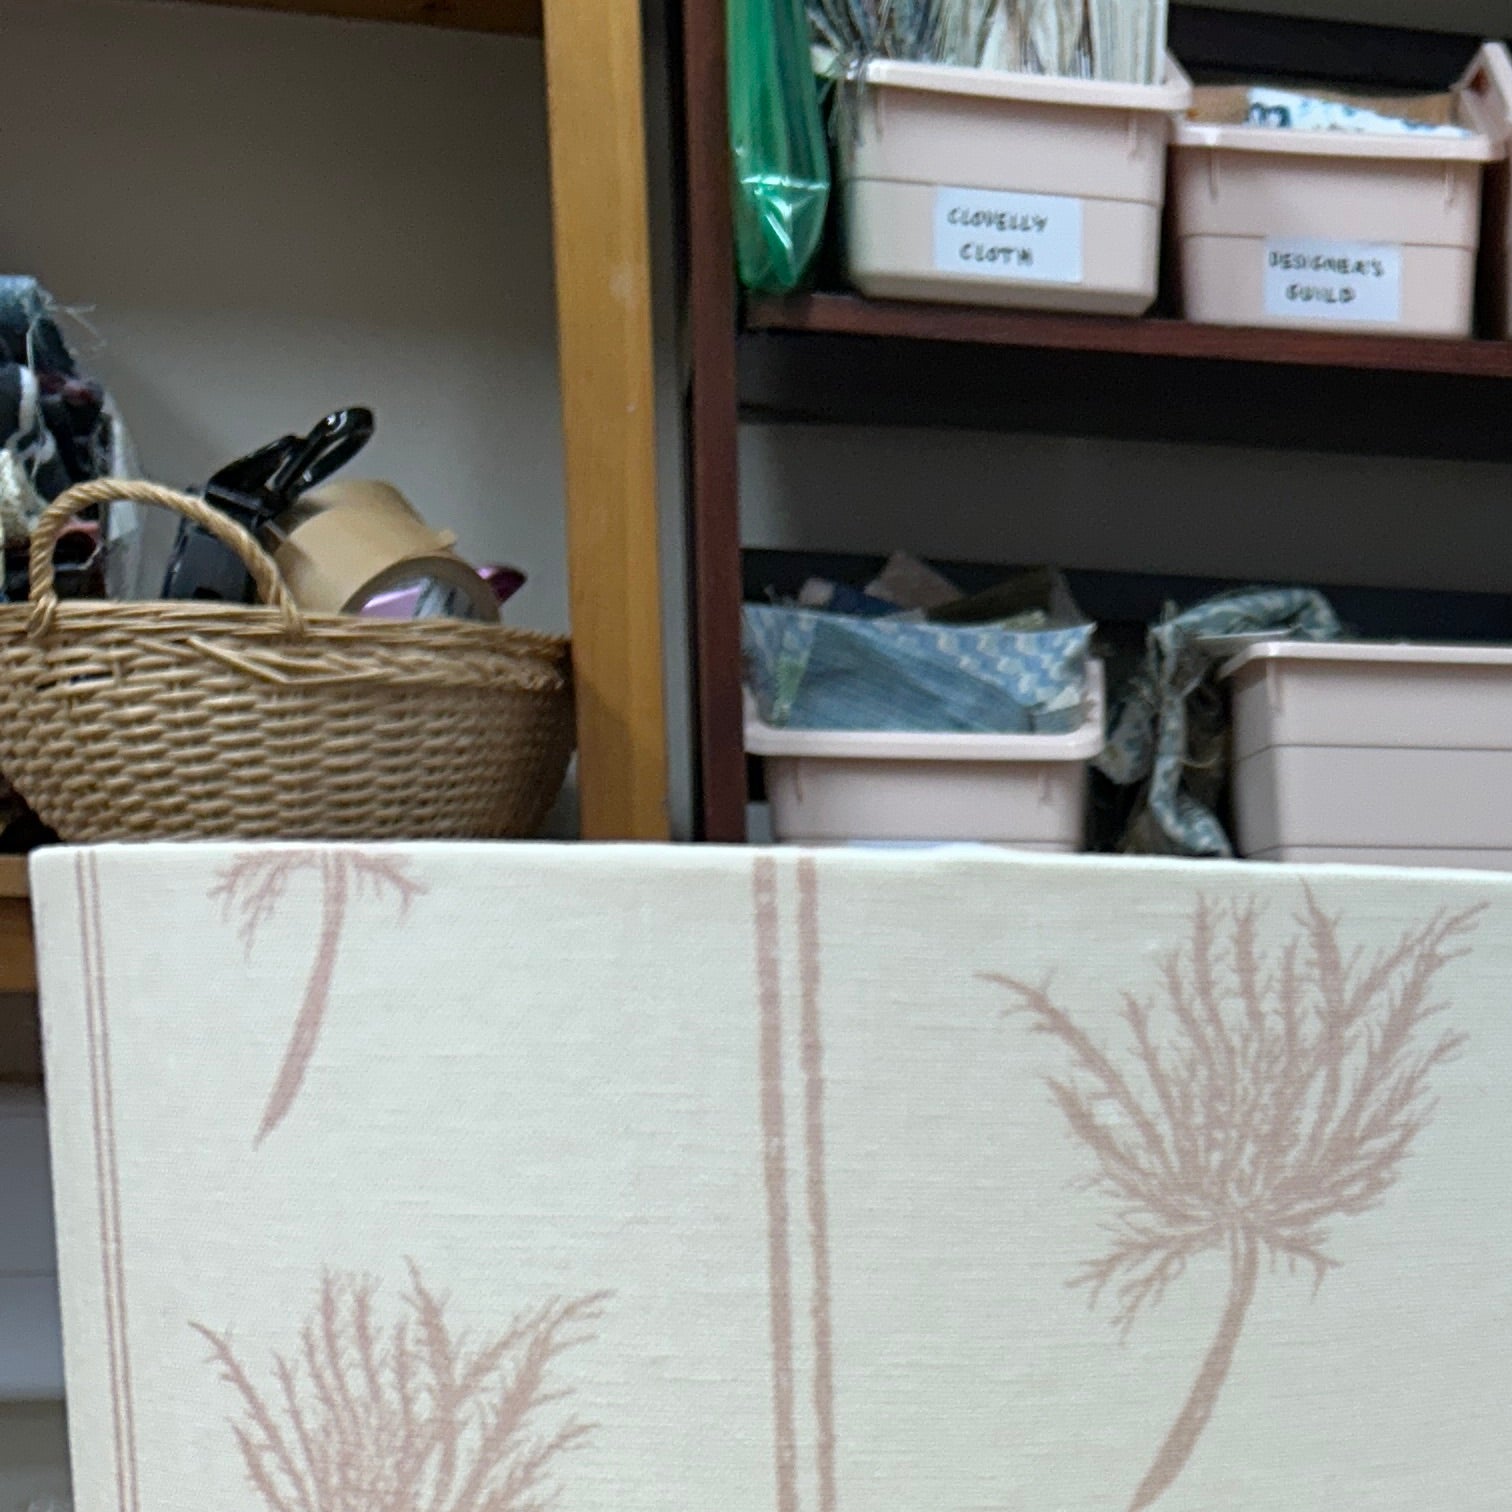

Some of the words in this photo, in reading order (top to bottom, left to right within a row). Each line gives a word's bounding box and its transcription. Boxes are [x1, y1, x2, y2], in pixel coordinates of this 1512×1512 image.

[946, 206, 1049, 232] CLOVELLY
[958, 241, 1034, 266] CLOTH
[1284, 284, 1358, 304] GUILD
